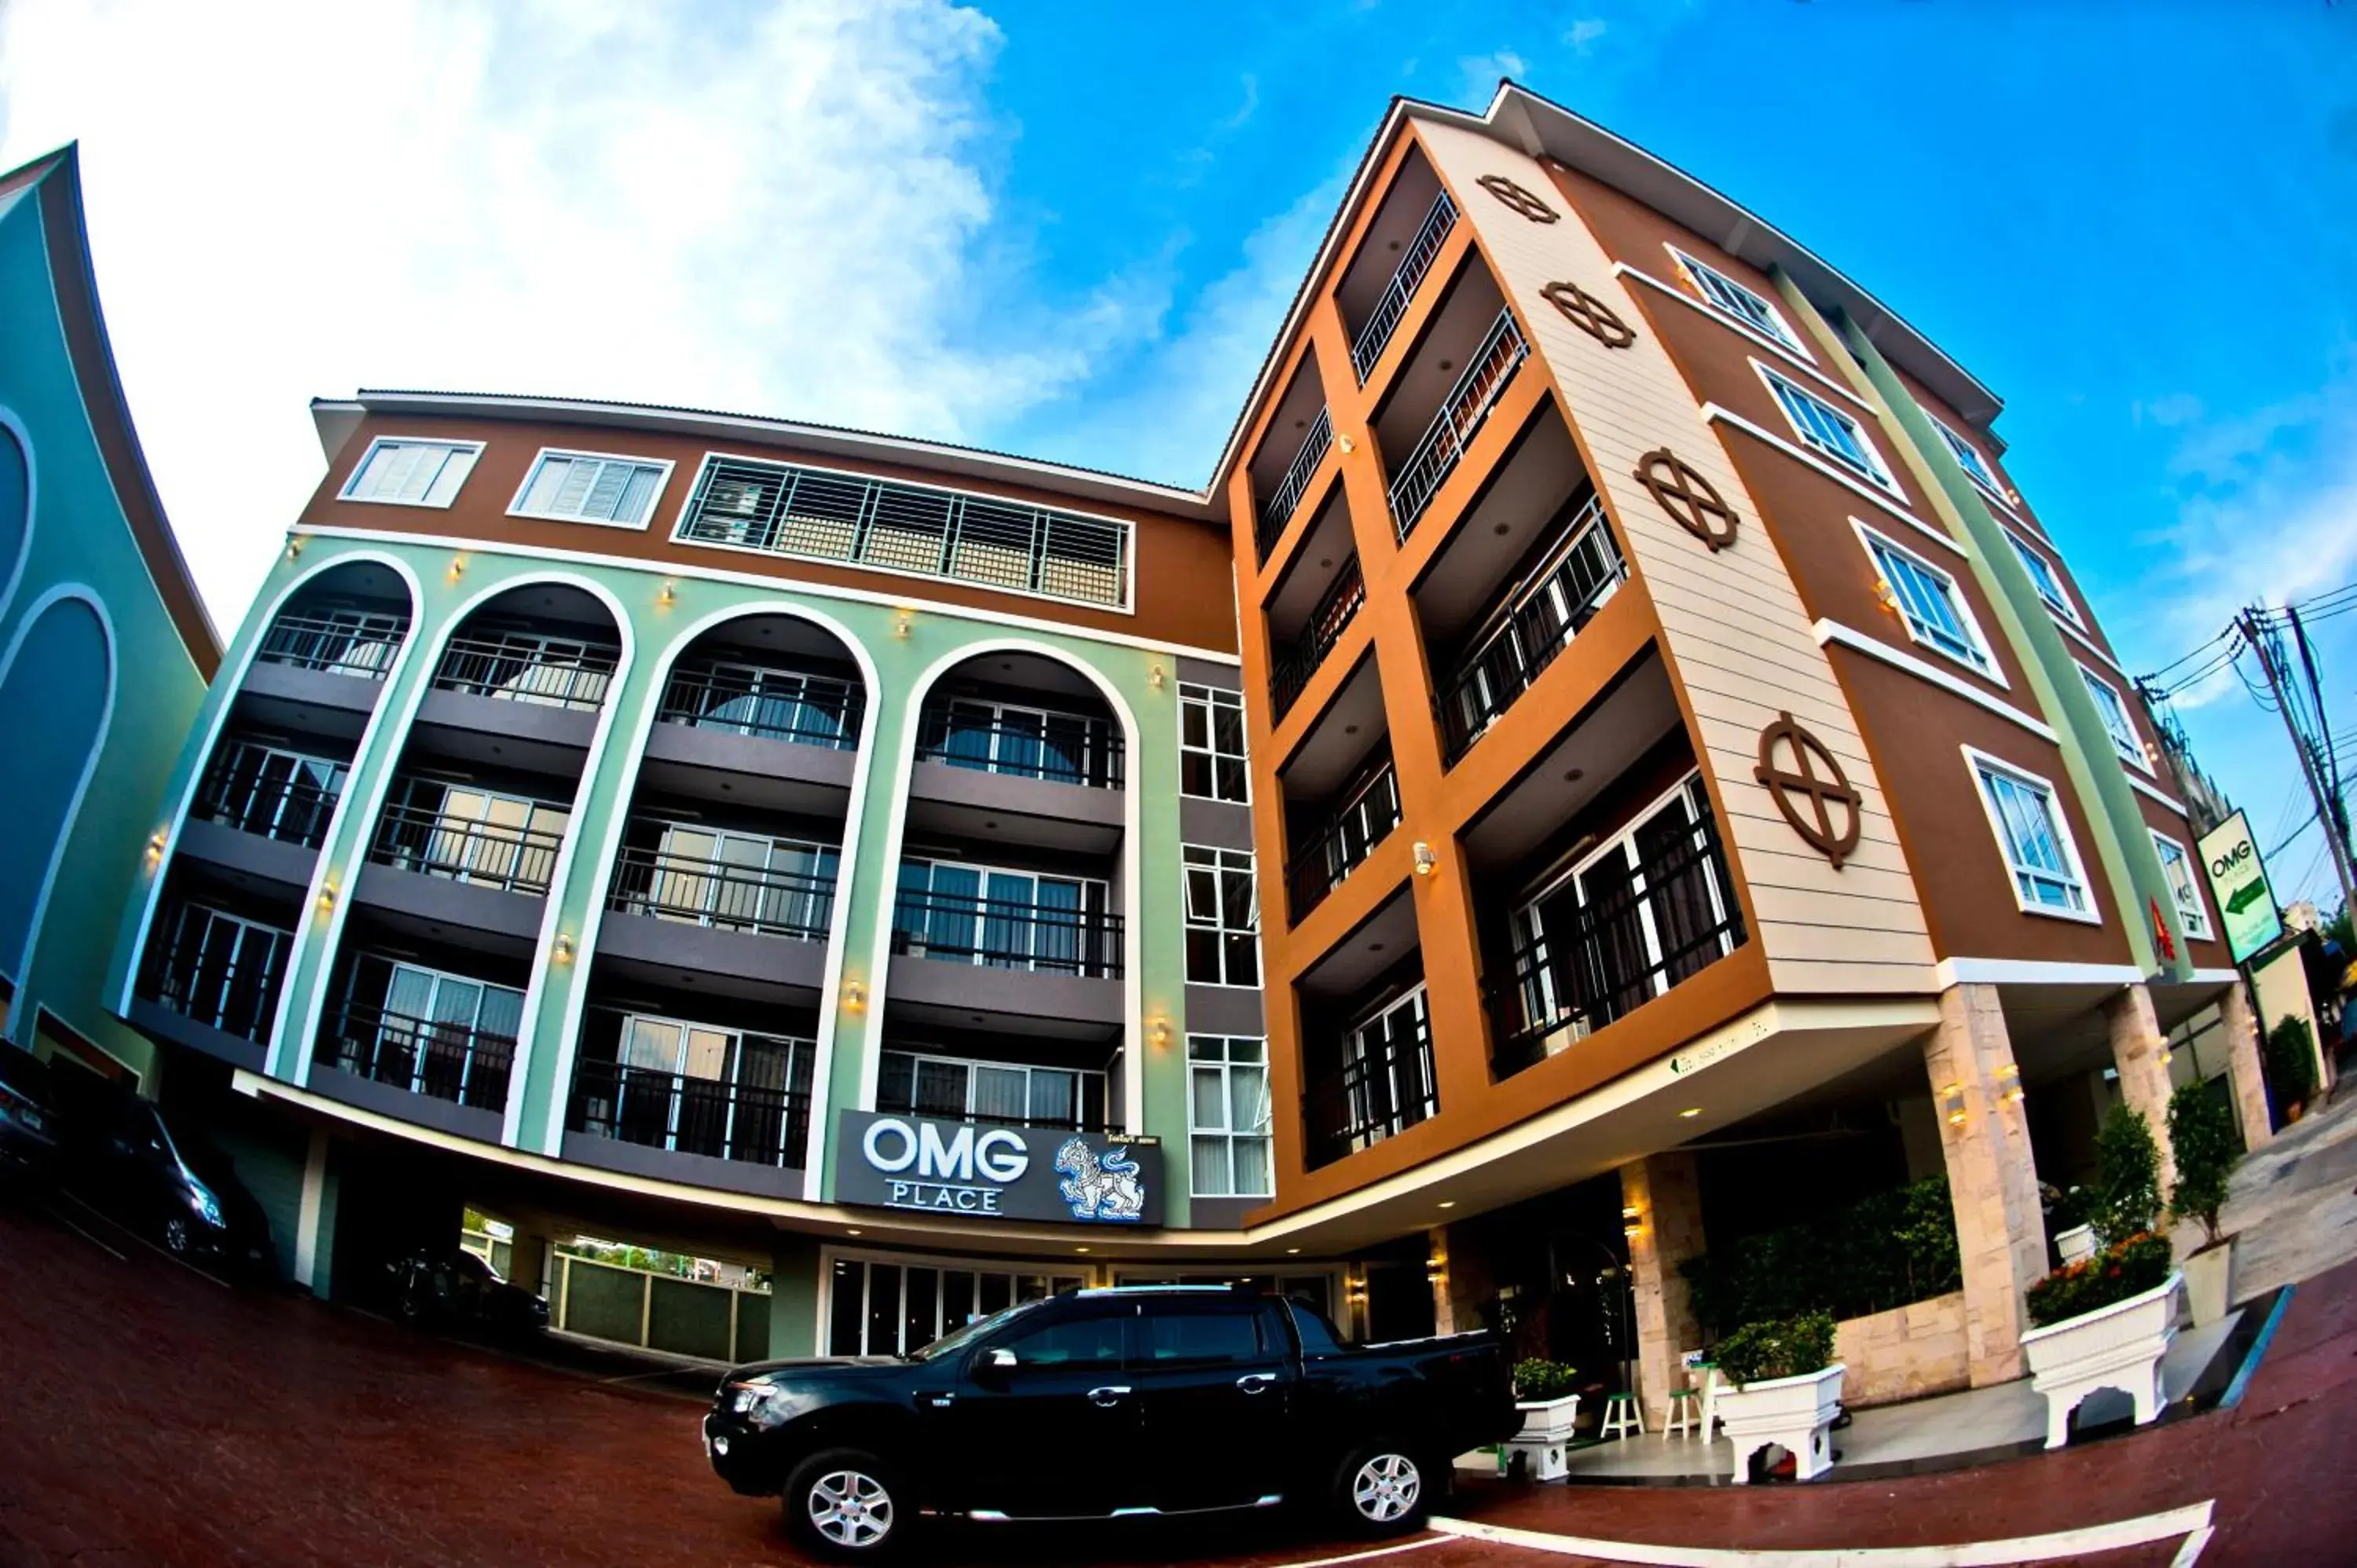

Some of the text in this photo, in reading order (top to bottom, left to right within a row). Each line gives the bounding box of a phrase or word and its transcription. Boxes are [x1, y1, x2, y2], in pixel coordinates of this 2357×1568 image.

[2212, 840, 2250, 877] OMG
[863, 1118, 1028, 1182] OMG
[893, 1183, 997, 1211] PLACE
